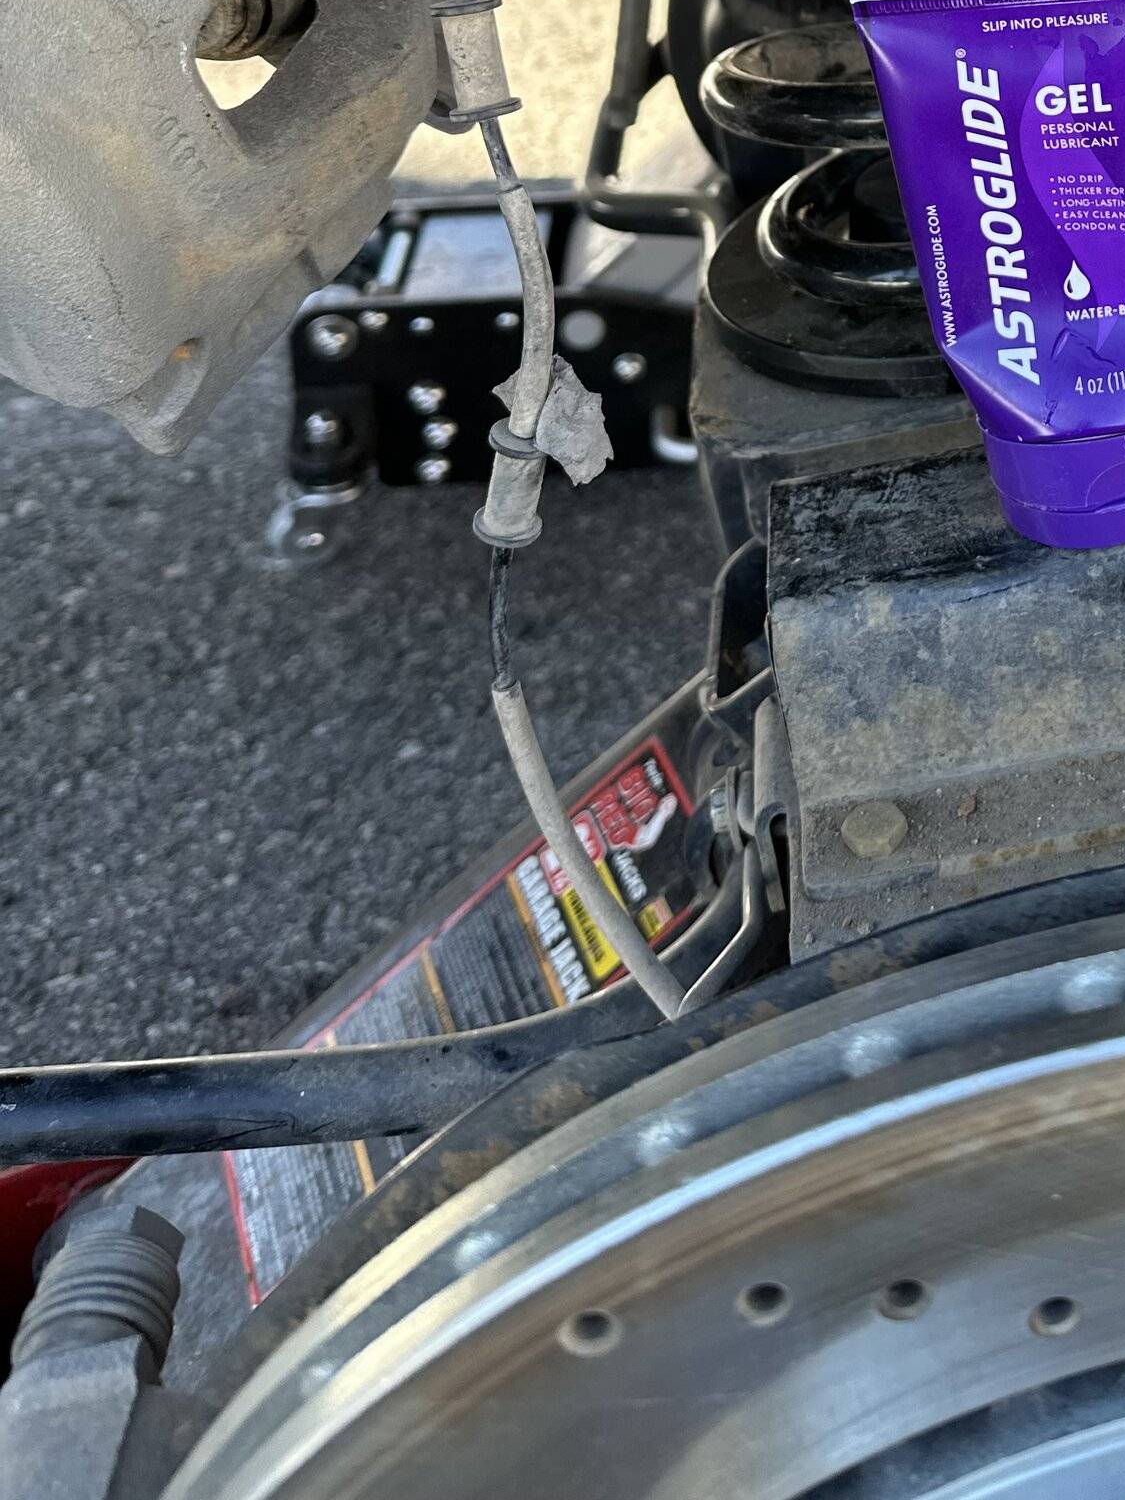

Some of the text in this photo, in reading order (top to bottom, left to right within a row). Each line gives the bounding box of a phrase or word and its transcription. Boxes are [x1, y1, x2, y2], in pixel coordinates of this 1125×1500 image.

[981, 12, 1109, 33] SLIP INTO PLEASURE
[1035, 82, 1113, 116] GEL
[1040, 121, 1116, 135] PERSONAL
[1043, 136, 1120, 150] LUBRICANT
[1057, 174, 1104, 184] NO DRIP
[1059, 187, 1102, 195] THICKER
[1062, 210, 1090, 220] EASY
[1064, 222, 1116, 231] CONDOM
[926, 204, 958, 347] WWW.ASTROGLIDE.COM
[1074, 376, 1084, 395] 4
[1087, 378, 1105, 394] oz
